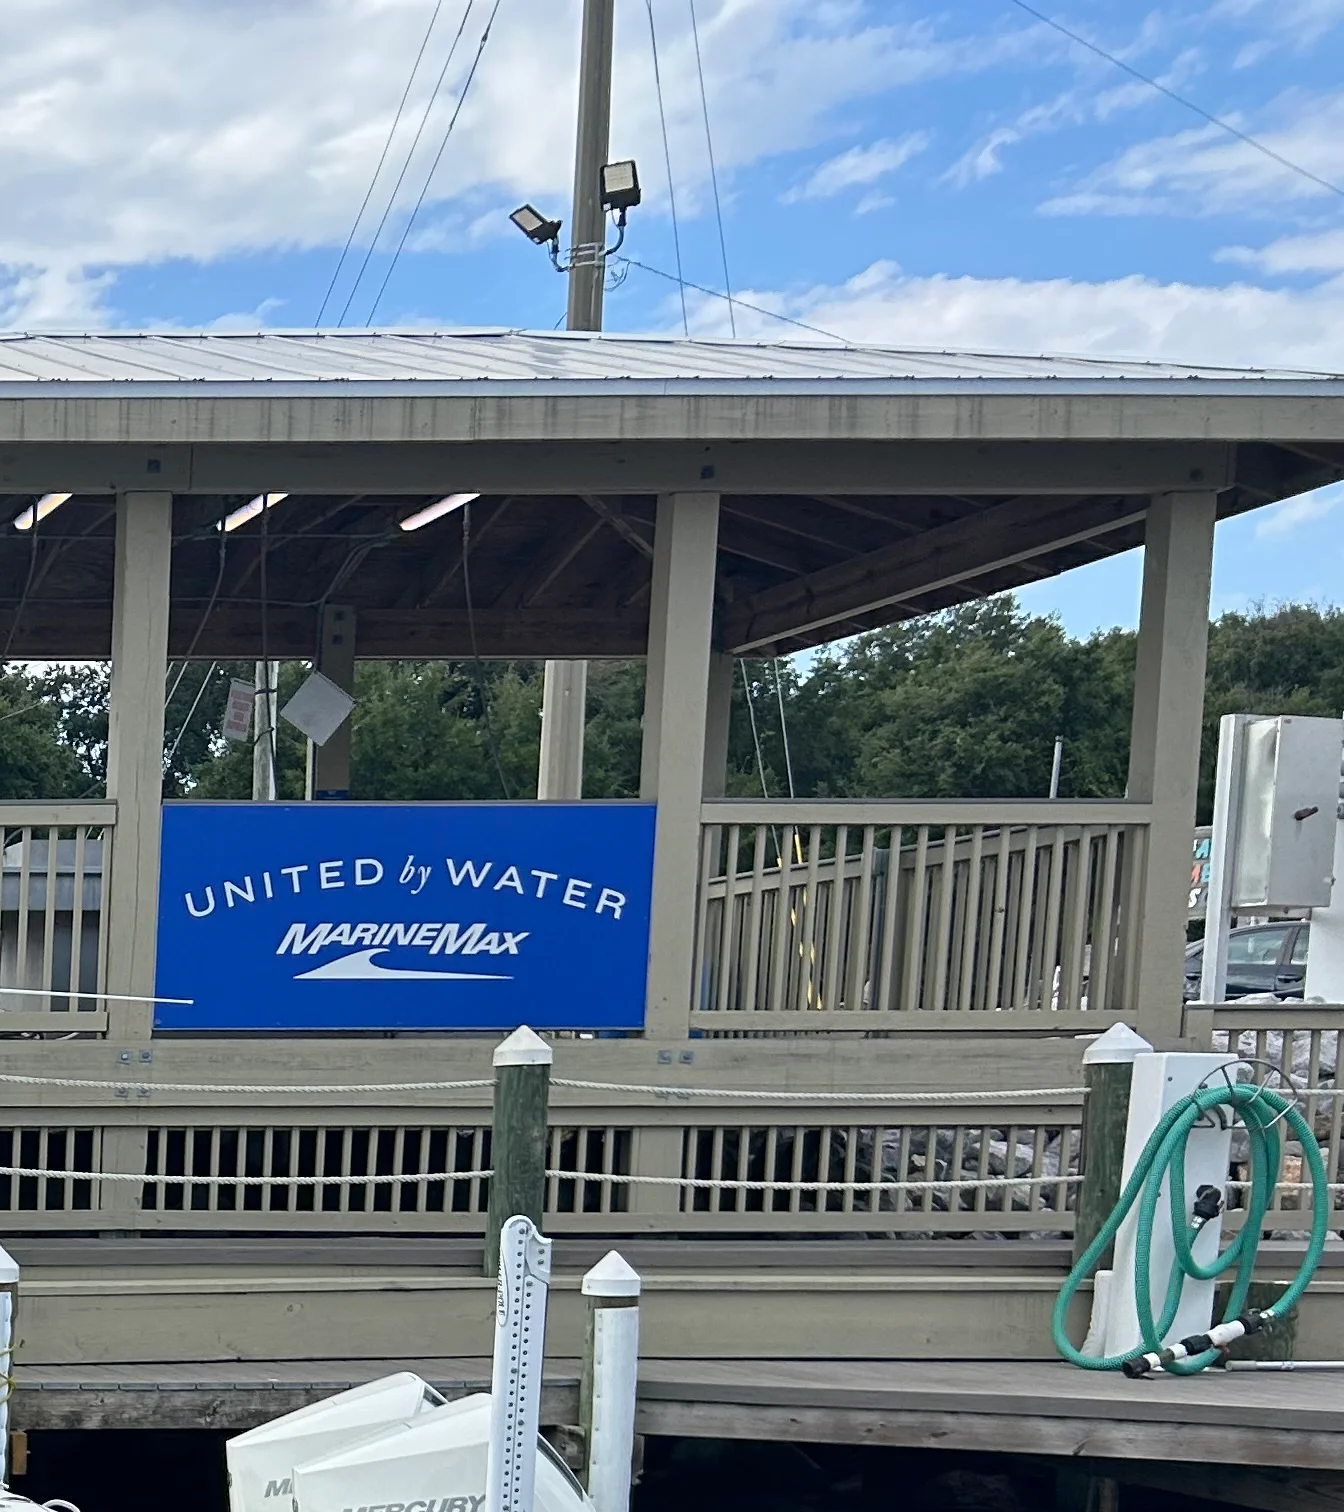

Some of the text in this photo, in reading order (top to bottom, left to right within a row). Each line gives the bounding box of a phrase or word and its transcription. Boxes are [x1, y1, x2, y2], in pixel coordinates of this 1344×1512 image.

[185, 854, 627, 920] UNITED by WATER
